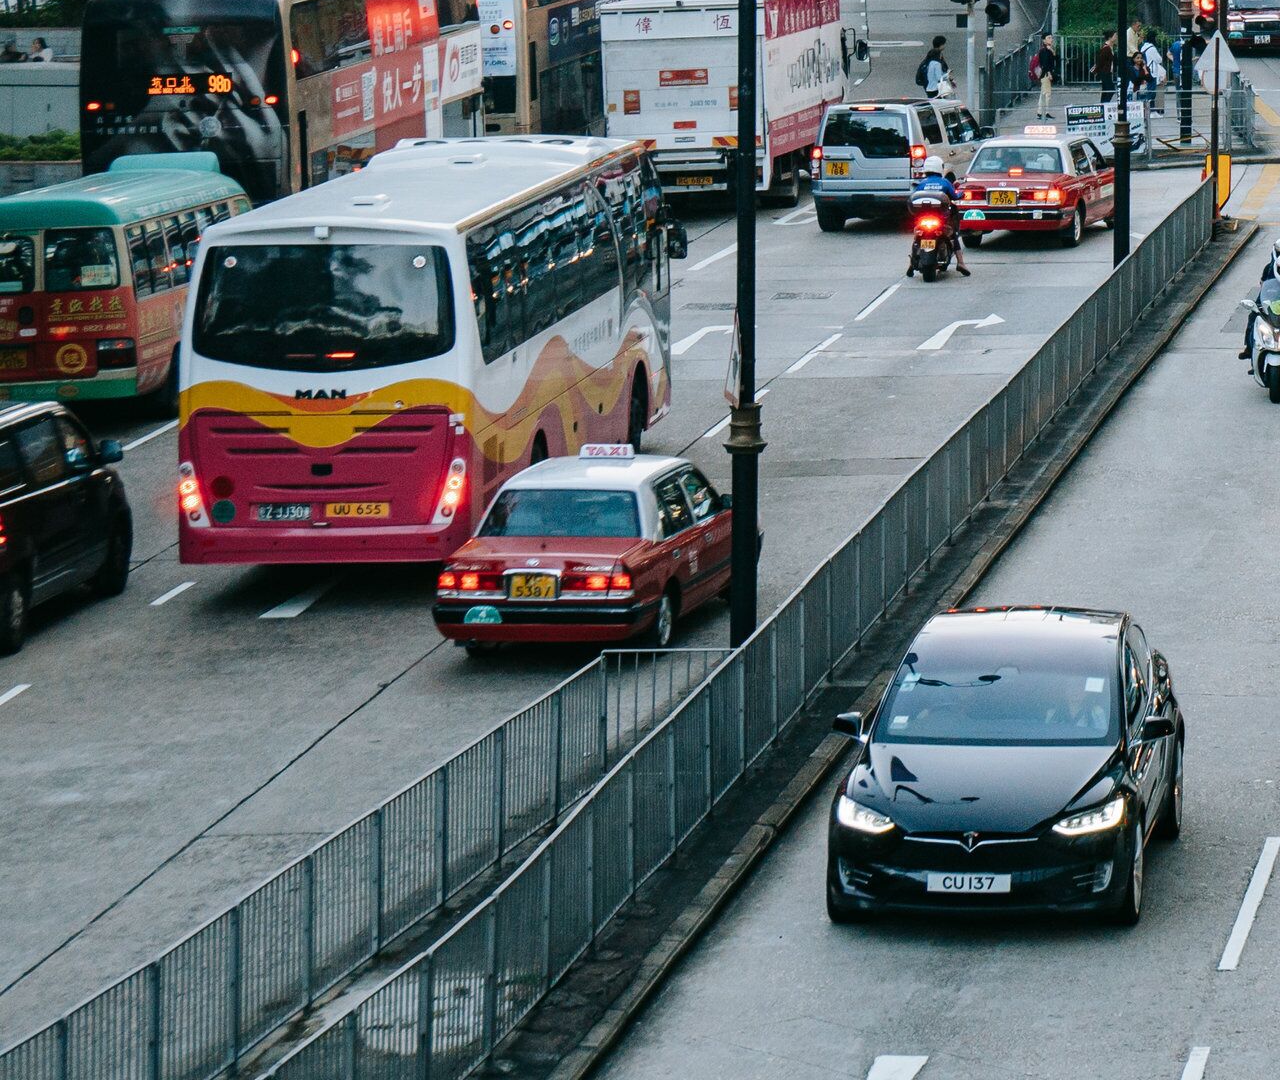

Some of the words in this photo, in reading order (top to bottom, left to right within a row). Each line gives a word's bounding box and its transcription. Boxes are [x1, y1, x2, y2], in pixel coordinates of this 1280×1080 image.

[208, 74, 232, 94] 98D
[294, 389, 347, 400] MAN
[585, 445, 629, 457] TAXI
[356, 504, 382, 515] 655
[942, 876, 966, 890] CU
[967, 876, 995, 890] 137
